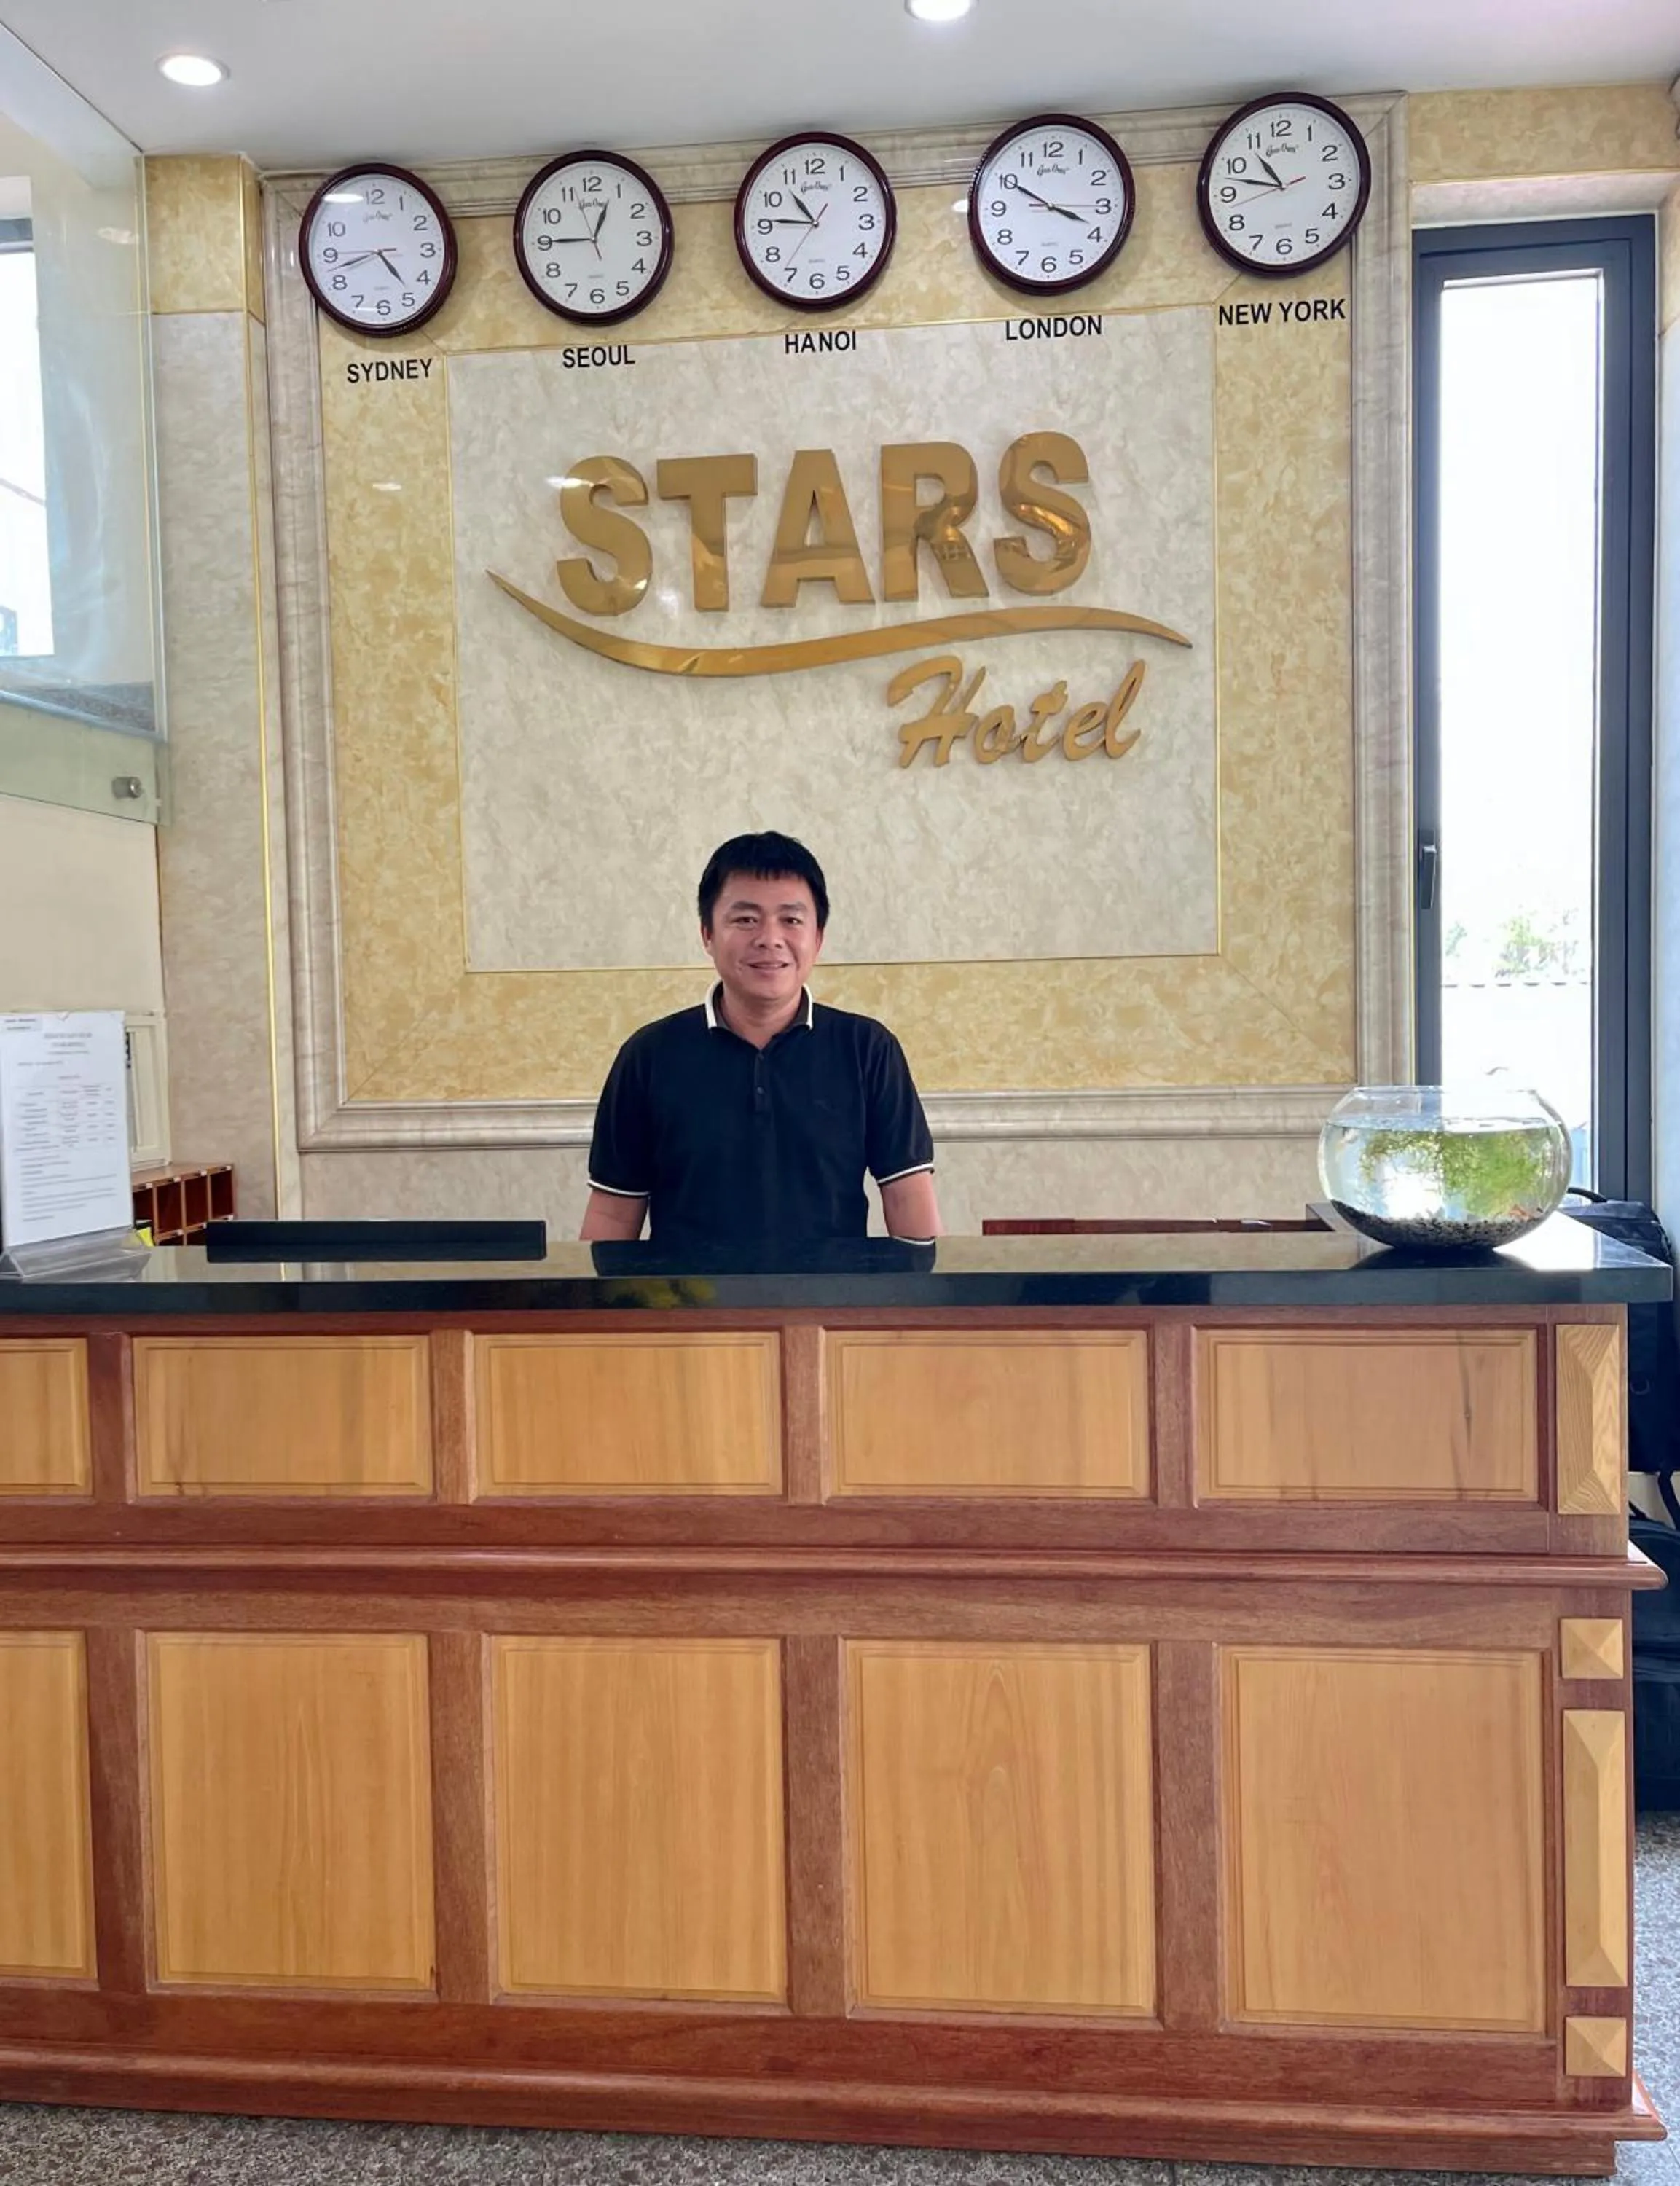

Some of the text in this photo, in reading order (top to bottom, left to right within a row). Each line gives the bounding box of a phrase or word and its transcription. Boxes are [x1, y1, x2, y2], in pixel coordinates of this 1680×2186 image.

[1270, 120, 1292, 138] 12
[1307, 125, 1312, 141] 1
[1247, 133, 1260, 149] 11
[1043, 141, 1064, 158] 12
[1078, 149, 1083, 165] 1
[1322, 145, 1338, 162] 2
[805, 158, 825, 174] 12
[1021, 152, 1032, 168] 11
[1227, 157, 1247, 174] 10
[784, 169, 796, 184] 11
[839, 165, 844, 181] 1
[999, 173, 1018, 189] 10
[1091, 170, 1107, 186] 2
[583, 176, 602, 192] 12
[1328, 173, 1346, 190] 3
[366, 189, 385, 204] 12
[562, 187, 574, 202] 11
[617, 184, 621, 198] 1
[854, 187, 868, 202] 2
[1220, 186, 1236, 203] 9
[399, 197, 404, 210] 1
[764, 192, 782, 207] 10
[1095, 198, 1111, 214] 3
[543, 208, 561, 224] 10
[630, 204, 645, 219] 2
[991, 200, 1007, 216] 9
[1322, 203, 1338, 219] 4
[328, 222, 345, 237] 10
[414, 216, 427, 231] 2
[758, 219, 773, 235] 9
[859, 214, 874, 230] 3
[1229, 214, 1245, 230] 8
[636, 231, 652, 246] 3
[997, 229, 1013, 245] 8
[1087, 227, 1103, 242] 4
[1249, 235, 1263, 250] 7
[1305, 228, 1319, 243] 5
[420, 243, 436, 258] 3
[537, 235, 552, 251] 9
[852, 242, 868, 258] 4
[1276, 238, 1292, 255] 6
[323, 248, 338, 263] 9
[766, 247, 780, 262] 8
[1016, 251, 1029, 265] 7
[1069, 250, 1083, 265] 5
[546, 263, 560, 278] 8
[632, 258, 646, 273] 4
[1041, 256, 1056, 272] 6
[417, 270, 431, 284] 4
[785, 268, 797, 283] 7
[809, 273, 824, 289] 6
[836, 266, 850, 281] 5
[333, 275, 348, 290] 8
[565, 283, 578, 298] 7
[616, 281, 629, 295] 5
[351, 295, 364, 308] 7
[402, 293, 415, 306] 5
[590, 289, 605, 304] 6
[377, 300, 391, 316] 6
[1219, 298, 1346, 326] NEW YORK
[1005, 315, 1102, 340] LONDON
[785, 330, 856, 353] HANOI
[562, 345, 635, 368] SEOUL
[347, 359, 432, 383] SYDNEY
[557, 430, 1091, 616] STARS
[887, 655, 1147, 769] Hotel
